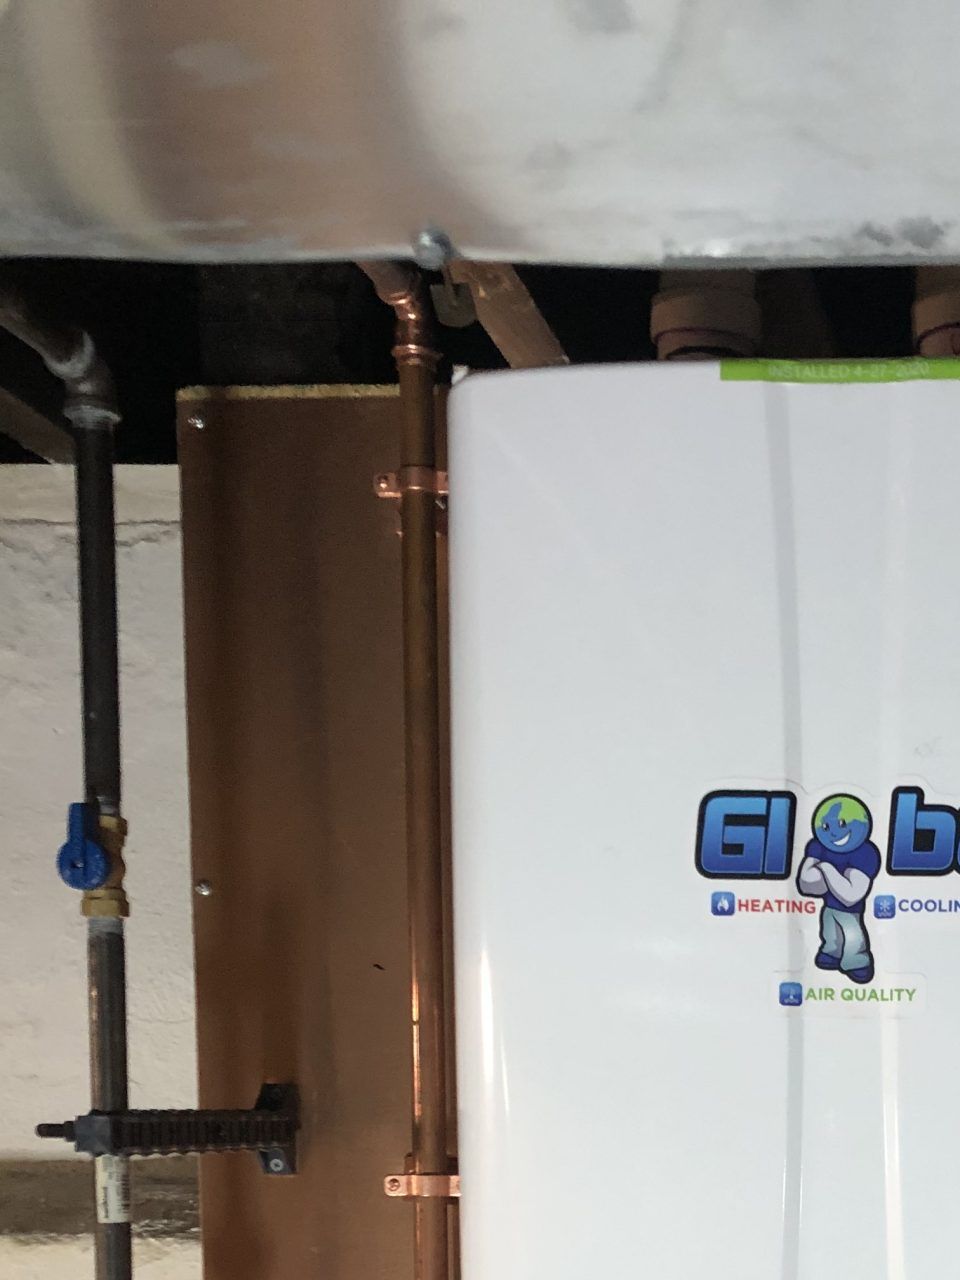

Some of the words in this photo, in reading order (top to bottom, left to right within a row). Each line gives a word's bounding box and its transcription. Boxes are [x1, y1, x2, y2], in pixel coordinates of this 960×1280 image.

[768, 364, 850, 379] INSTALLED
[737, 898, 816, 914] HEATING
[805, 988, 835, 1002] AIR
[841, 988, 917, 1002] QUALITY
